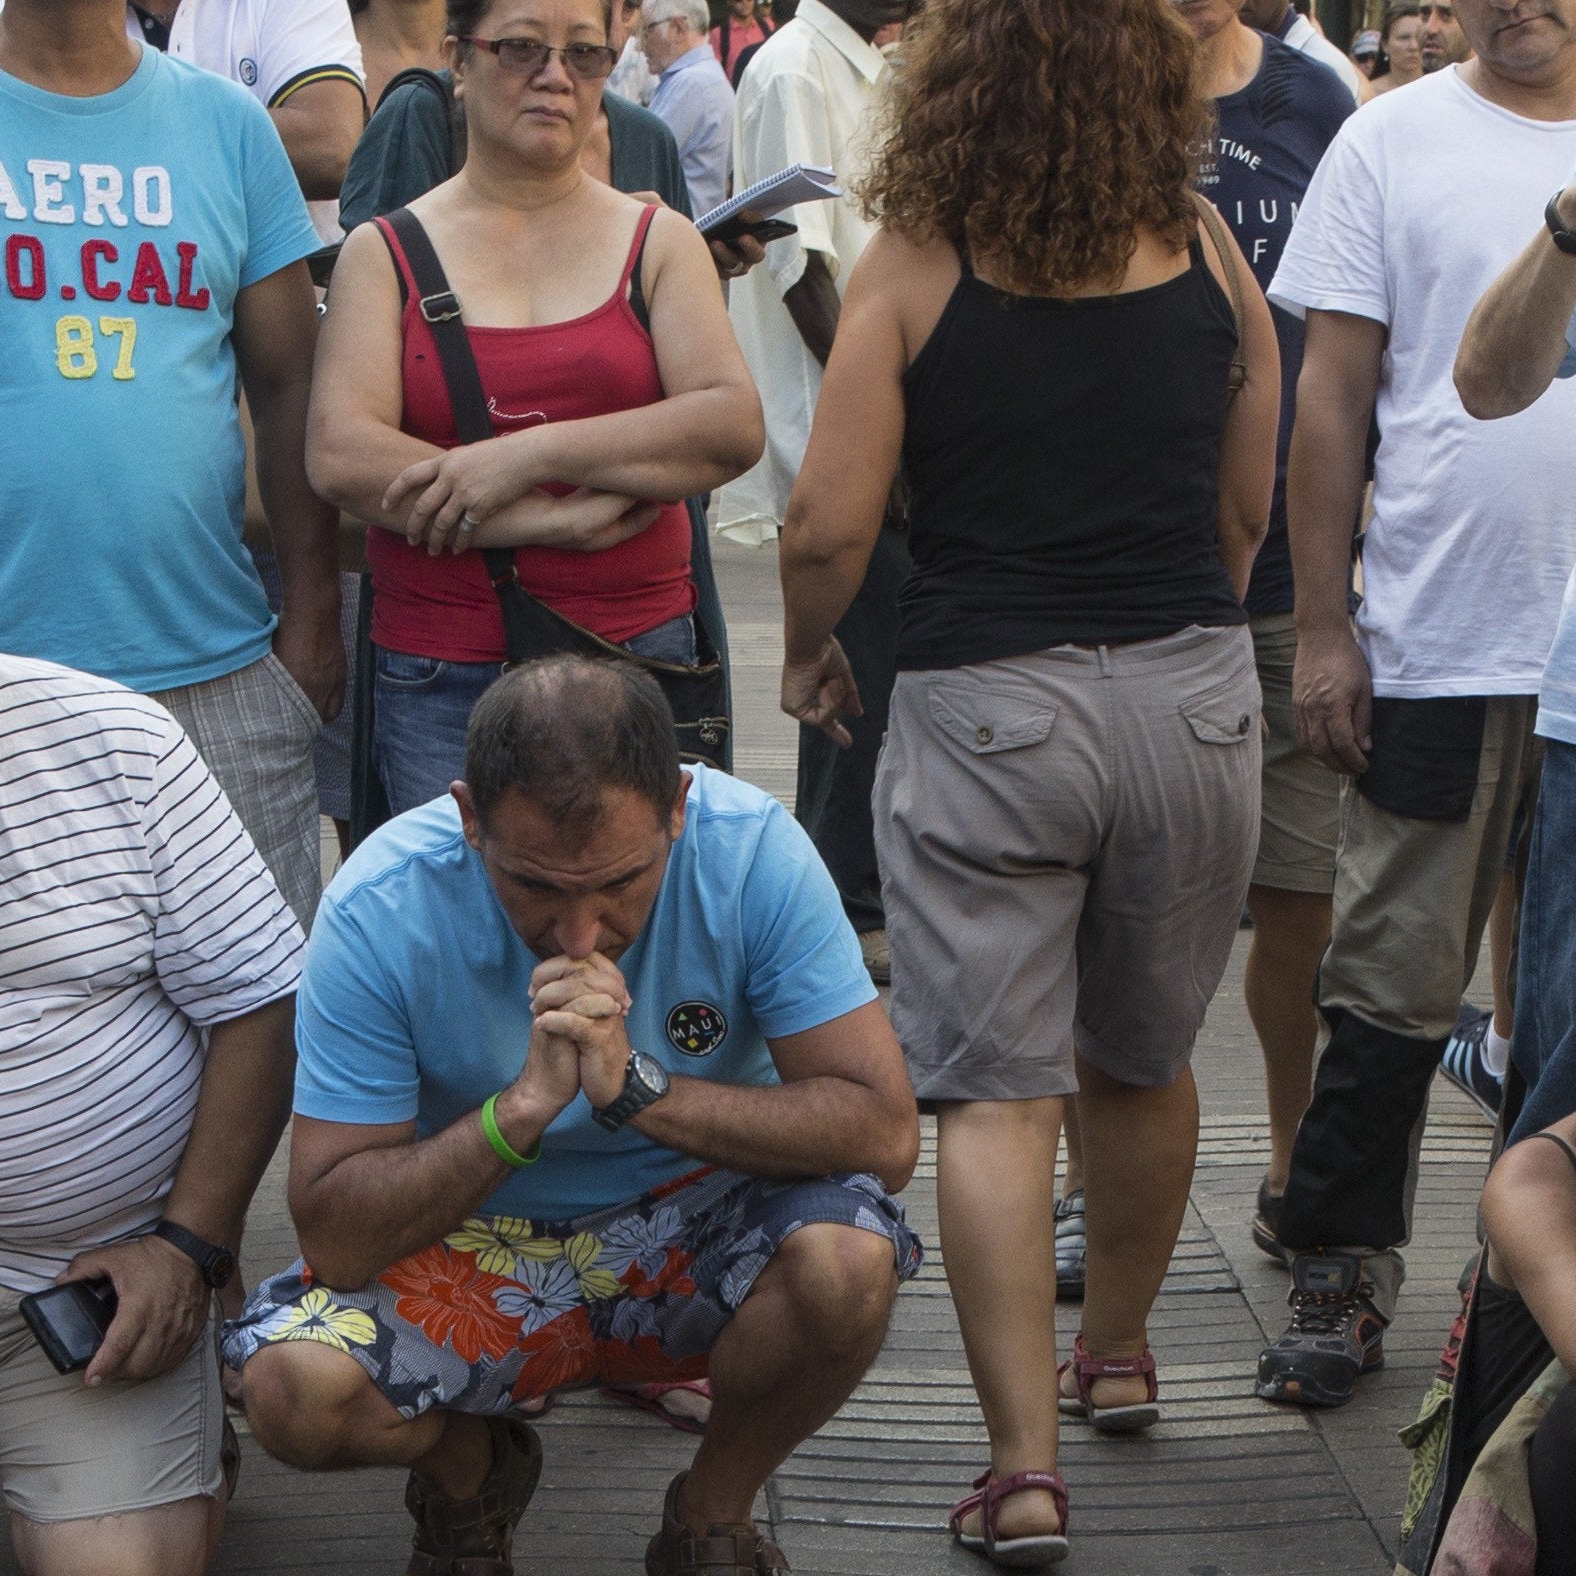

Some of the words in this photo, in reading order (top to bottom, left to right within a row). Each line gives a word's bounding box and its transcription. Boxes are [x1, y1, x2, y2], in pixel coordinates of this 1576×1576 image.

[1219, 138, 1262, 171] TIME
[54, 315, 137, 381] 87
[672, 1016, 721, 1040] MAUI
